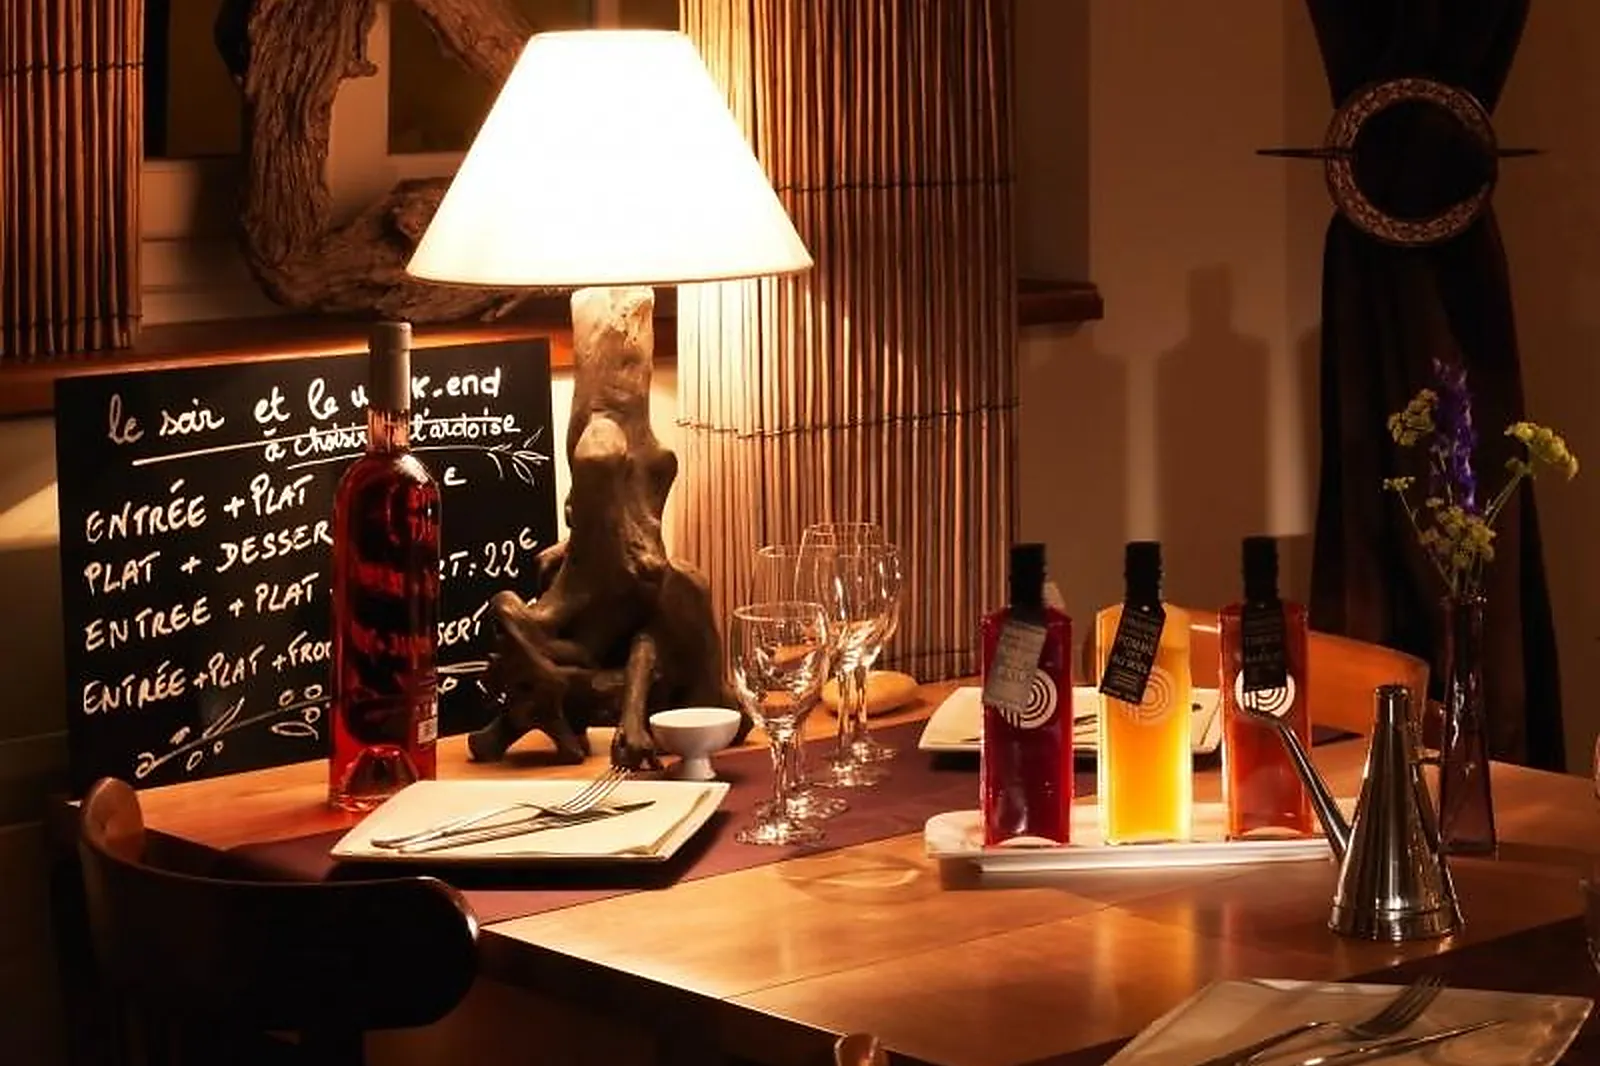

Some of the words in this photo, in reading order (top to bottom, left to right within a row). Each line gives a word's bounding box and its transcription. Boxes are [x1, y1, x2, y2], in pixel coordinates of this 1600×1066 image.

[108, 393, 144, 444] le
[159, 398, 225, 436] soir
[254, 386, 290, 423] et
[307, 378, 339, 420] le
[351, 366, 501, 407] wk-end
[86, 478, 207, 543] ENTRÉE
[250, 472, 314, 517] PLAT
[83, 551, 161, 597] PLAT
[215, 521, 335, 573] DESSER
[84, 596, 212, 651] ENTREE
[254, 572, 320, 614] PLAT
[83, 660, 187, 715] ENTRÉE
[437, 600, 490, 646] SERT
